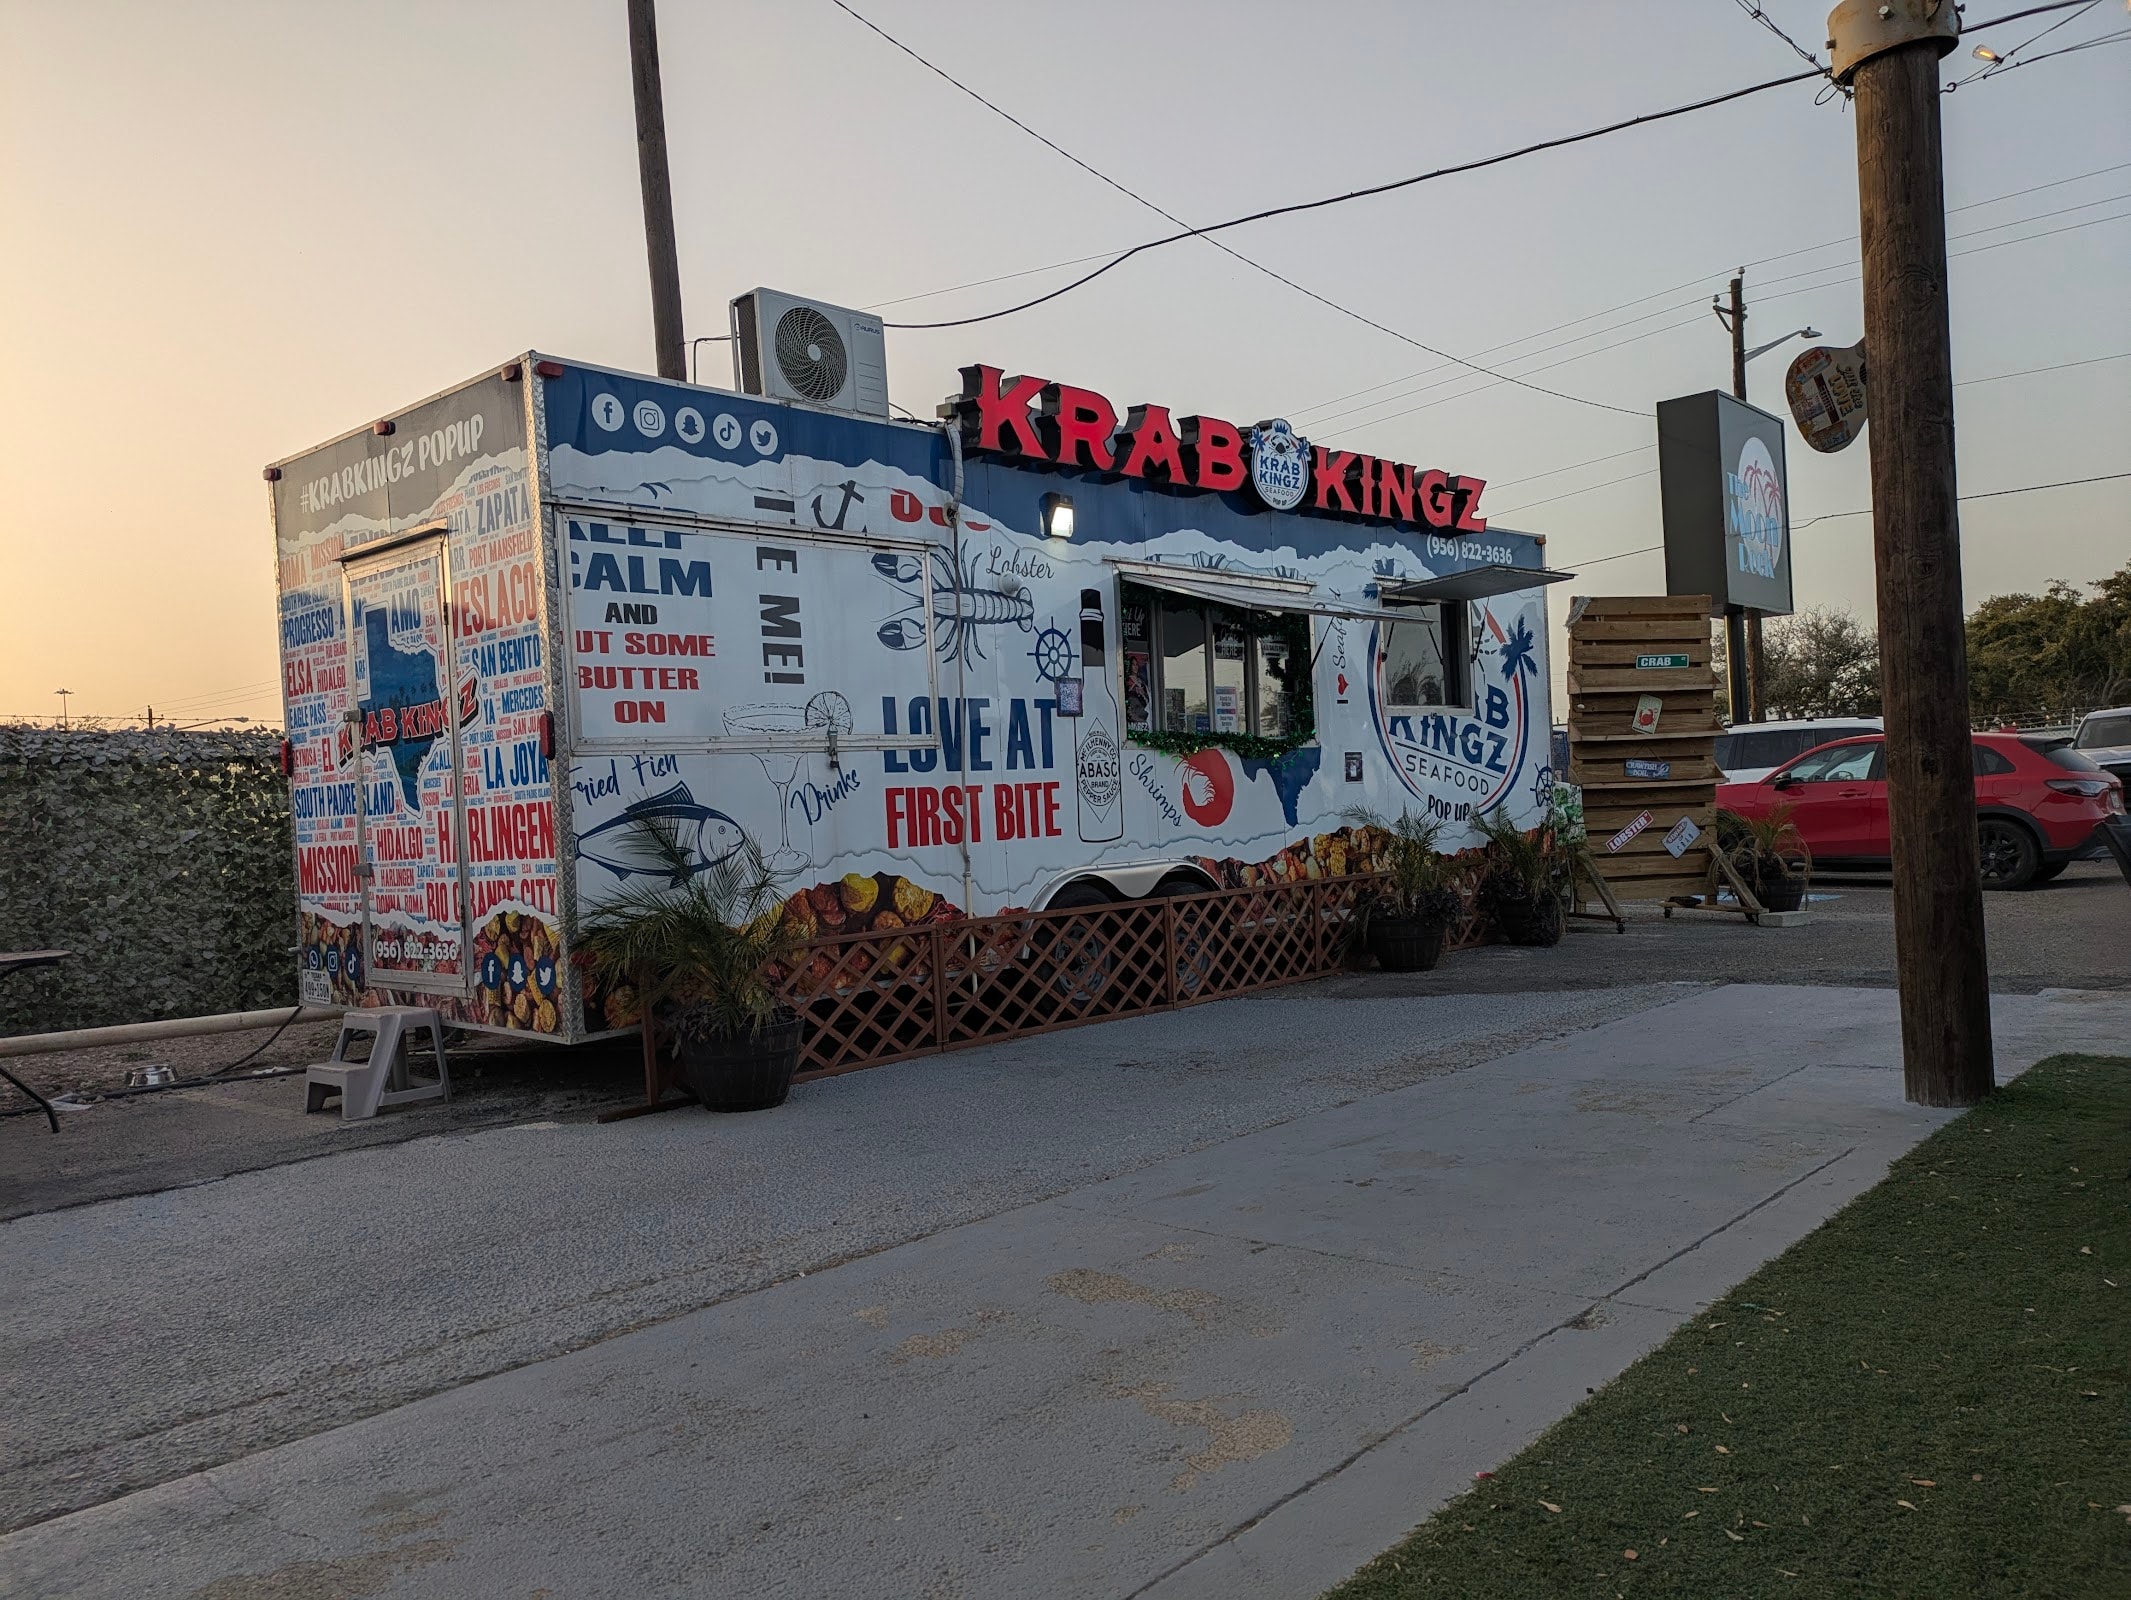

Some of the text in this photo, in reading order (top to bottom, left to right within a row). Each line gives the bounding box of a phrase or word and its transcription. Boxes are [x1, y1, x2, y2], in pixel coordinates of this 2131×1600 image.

[300, 413, 485, 513] #KRABKINGZ POPUP
[968, 363, 1487, 533] KRAB KINGZ
[1260, 455, 1300, 476] KRAB
[1259, 469, 1300, 490] KINGZ
[1264, 486, 1294, 497] SEAFOOD
[1727, 472, 1749, 501] The
[475, 483, 530, 536] ZAPATA
[311, 532, 345, 571] MISSION
[469, 544, 487, 569] PORT
[489, 529, 533, 563] MANSFIELD
[986, 545, 1055, 580] Lobster
[1426, 532, 1513, 566] (956) 822-3636
[280, 553, 307, 592] ROMA
[284, 606, 334, 650] PROGRESSO
[604, 602, 658, 625] AND
[472, 634, 541, 678] SAN BENITO
[574, 630, 716, 657] UT SOME
[286, 657, 346, 698] ELSA HIDALGO
[578, 666, 700, 691] BUTTER
[1640, 657, 1672, 667] CRAB
[309, 702, 327, 726] PASS
[501, 685, 545, 715] MERCEDES
[614, 700, 666, 724] ON
[513, 717, 526, 736] SAN
[527, 714, 541, 734] JUA
[882, 696, 1057, 774] LOVE AT
[321, 737, 334, 773] EL
[1388, 715, 1509, 775] KINGZ
[484, 746, 506, 790] LA
[510, 741, 550, 787] JOYA
[1405, 754, 1490, 796] SEAFOOD
[295, 785, 325, 819] SOUTH
[327, 782, 357, 815] PADRE
[362, 781, 395, 816] SLAND
[463, 774, 480, 796] ERIA
[790, 769, 861, 825] Drinks
[1080, 778, 1119, 804] PEPPER SAUCE
[1091, 780, 1110, 790] BRAND
[1128, 752, 1182, 828] Shrimps
[885, 781, 1062, 849] FIRST BITE
[1427, 794, 1470, 822] POP UP
[376, 826, 424, 861] HIDALGO
[1609, 816, 1648, 851] LOBSTER
[1676, 833, 1694, 852] CRAB
[299, 844, 361, 894] MISSION
[381, 868, 415, 888] HARLINGEN
[416, 865, 435, 878] ZAPATA
[404, 893, 425, 914] ROMA
[426, 881, 449, 922] RIO
[520, 878, 557, 916] CITY
[373, 938, 458, 963] (956) 822-3636
